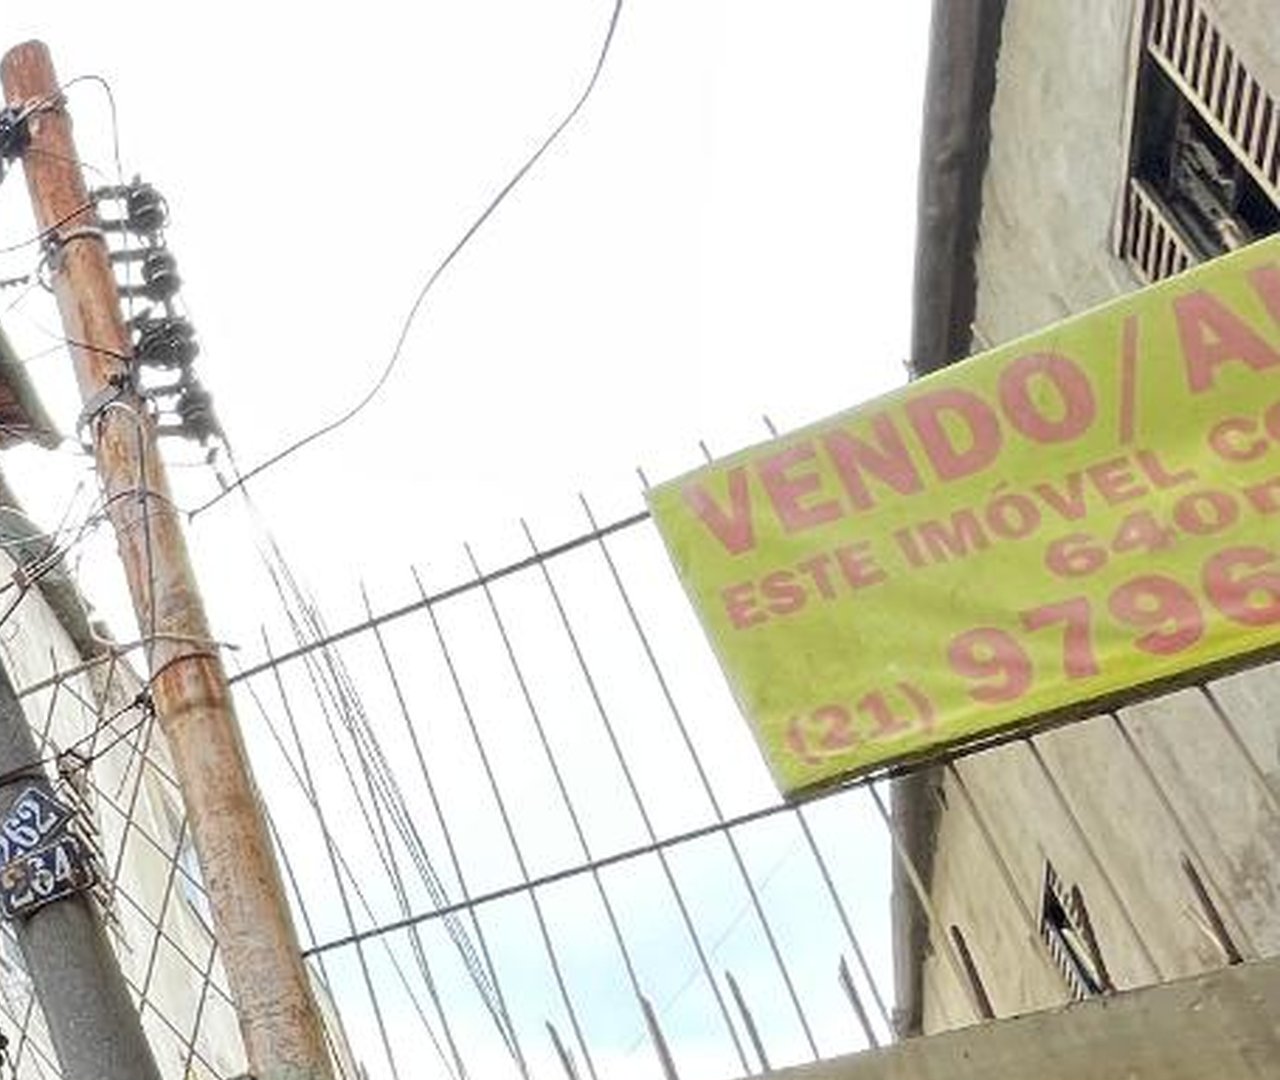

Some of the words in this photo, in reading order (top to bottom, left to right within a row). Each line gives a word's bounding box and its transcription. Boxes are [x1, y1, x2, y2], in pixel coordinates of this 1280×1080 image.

[719, 540, 889, 631] ESTE
[893, 447, 1199, 571] IMÓVEL
[783, 680, 941, 768] (21)
[945, 545, 1280, 706] 9796
